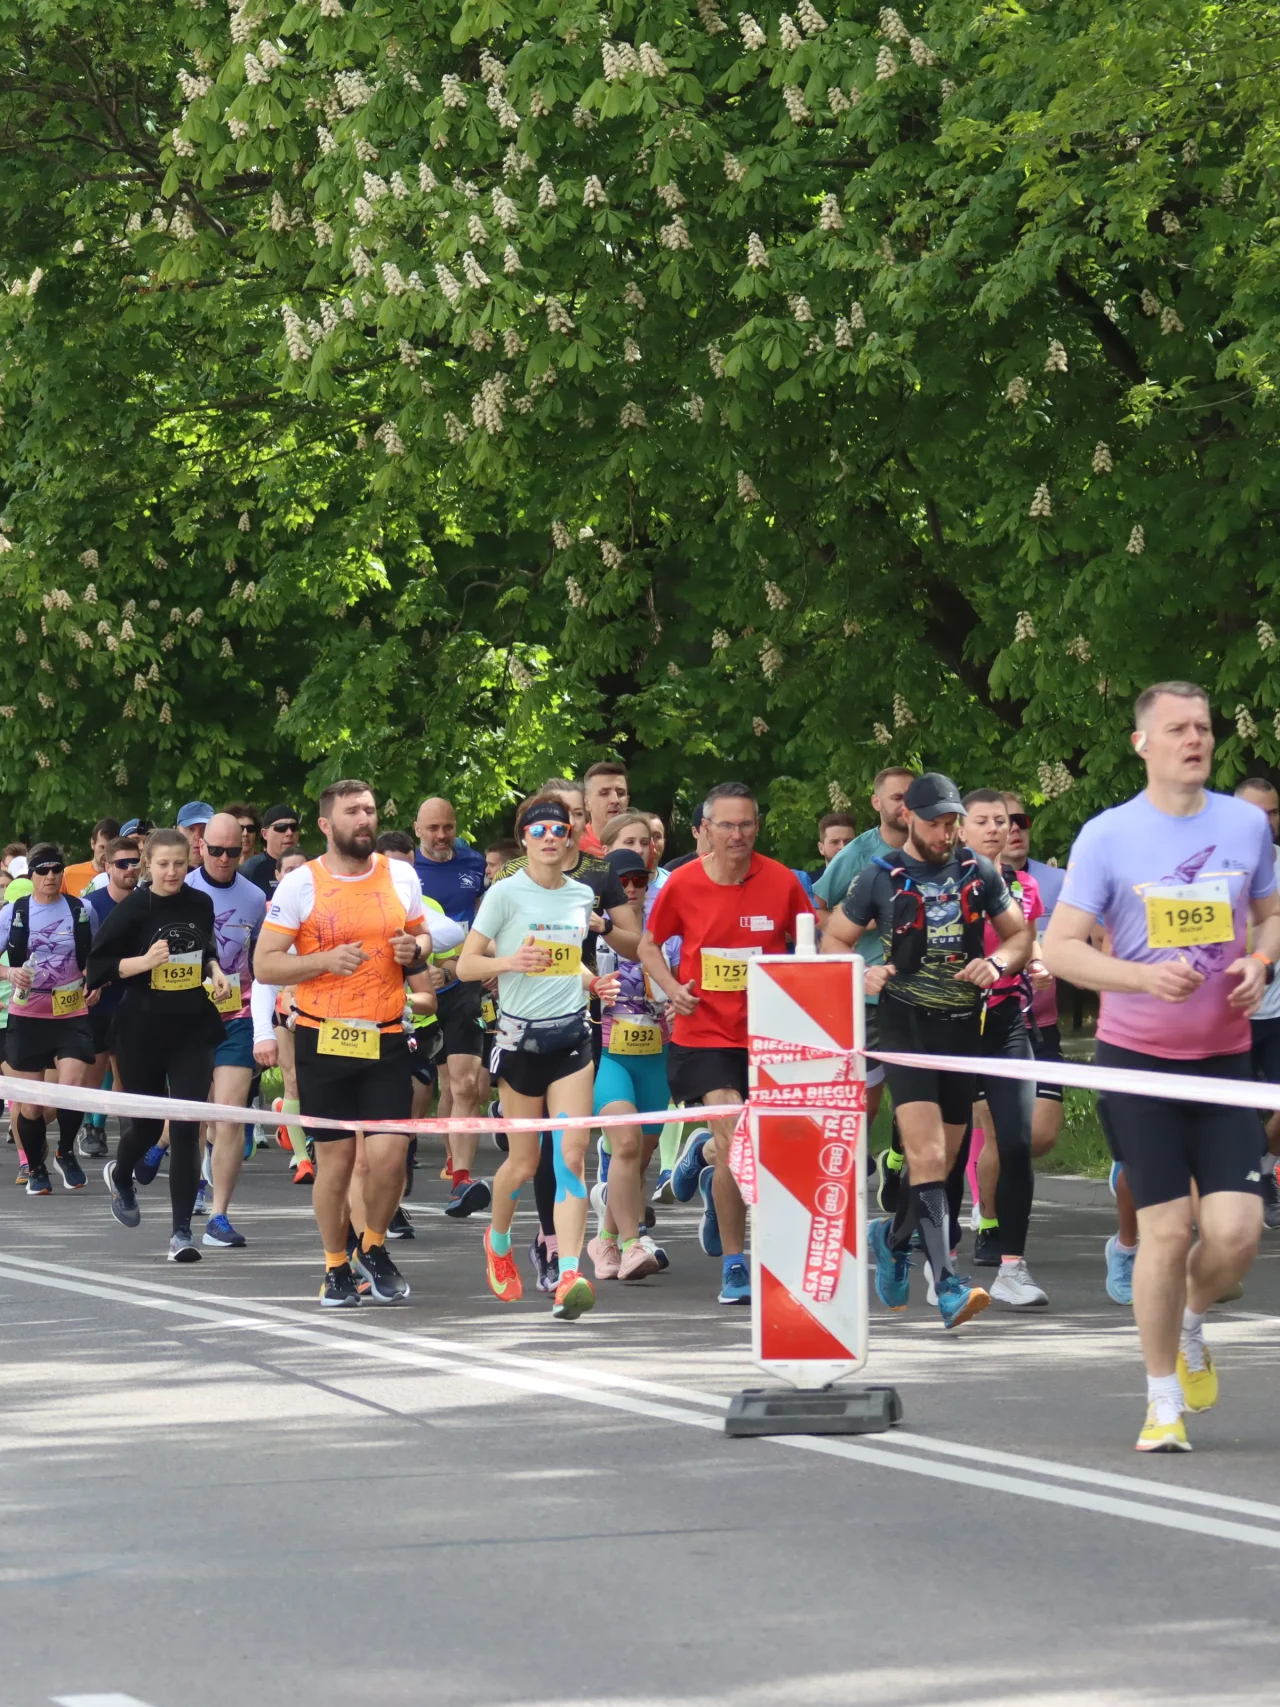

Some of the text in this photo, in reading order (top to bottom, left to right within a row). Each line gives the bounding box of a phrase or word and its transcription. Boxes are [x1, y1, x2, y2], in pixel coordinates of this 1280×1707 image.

[1165, 905, 1216, 927] 1963
[162, 966, 194, 979] 1634
[714, 964, 748, 977] 1757
[60, 991, 80, 1005] 2033
[330, 1027, 368, 1043] 2091
[623, 1029, 655, 1042] 1932
[749, 1086, 803, 1102] TRASA
[806, 1084, 858, 1101] BIEGU
[828, 1146, 844, 1174] FBB
[824, 1185, 840, 1213] FBB
[808, 1216, 829, 1267] BIEGU
[822, 1218, 844, 1272] TRASA
